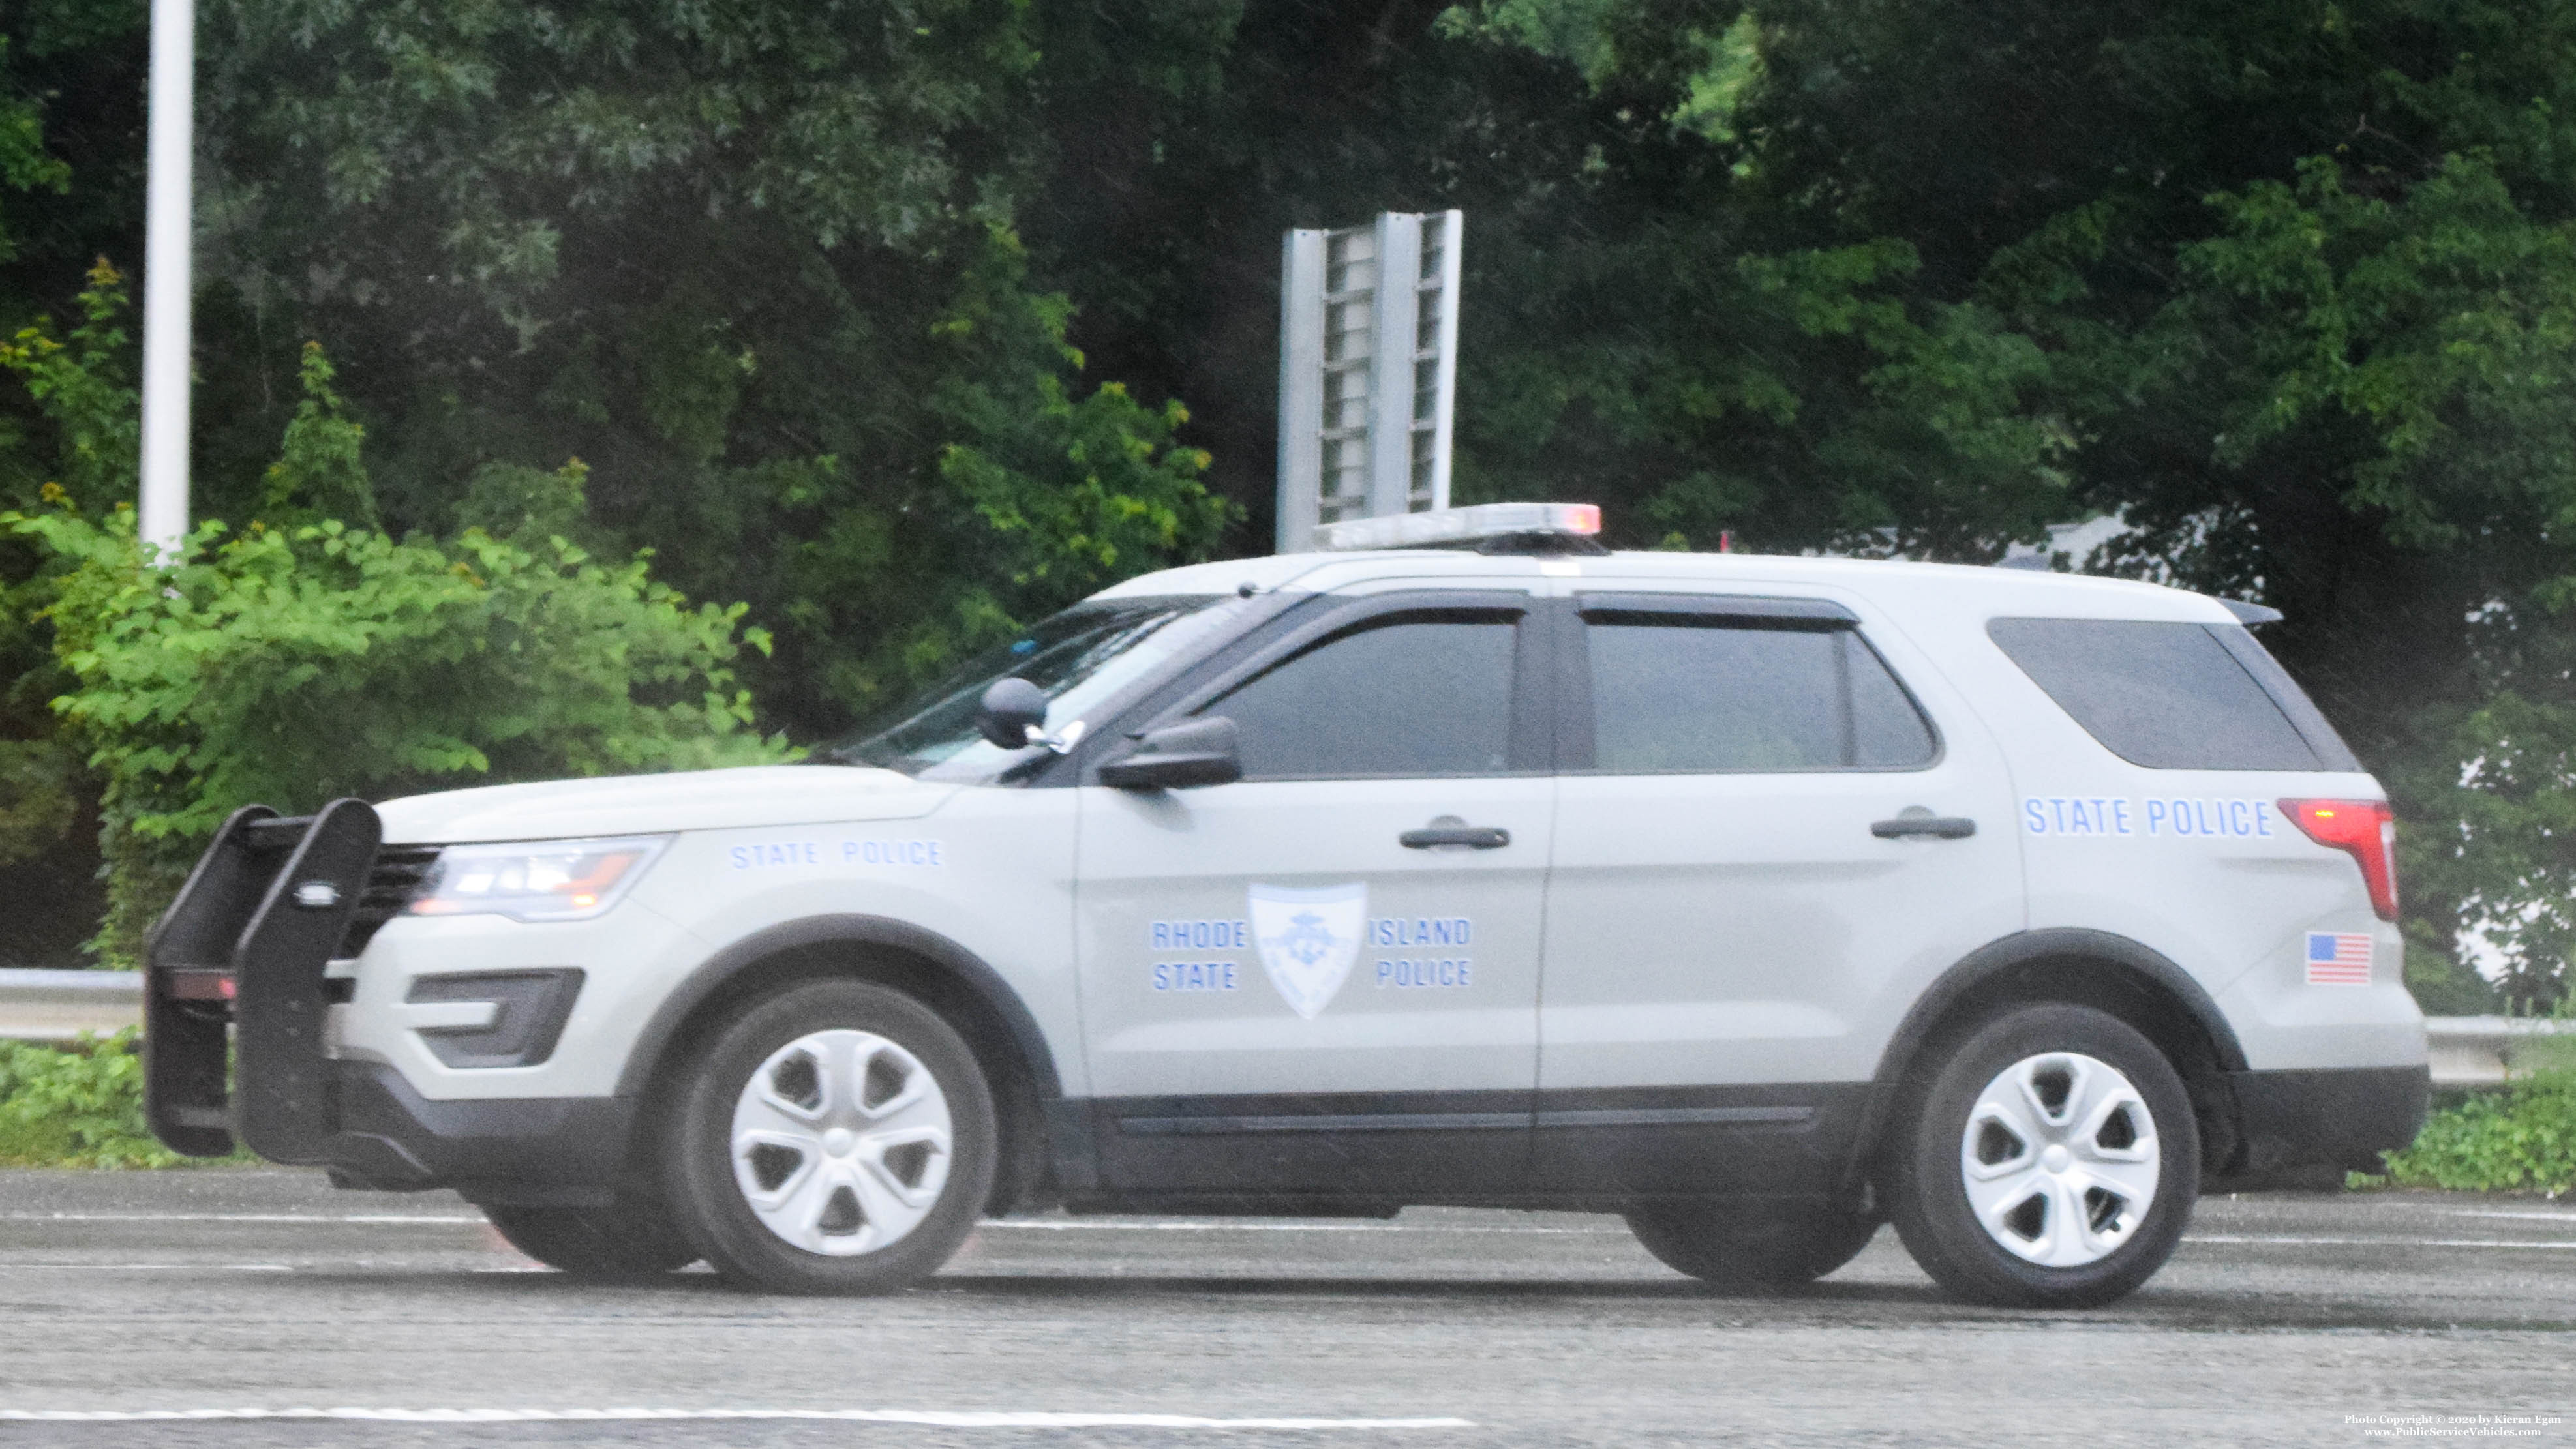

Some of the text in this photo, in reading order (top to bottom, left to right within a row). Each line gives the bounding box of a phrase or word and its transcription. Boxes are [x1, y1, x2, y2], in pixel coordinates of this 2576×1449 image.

[2025, 798, 2272, 836] STATE POLICE
[729, 841, 941, 870] STATE POLICE
[1152, 919, 1471, 949] RHODE ISLAND
[1153, 963, 1237, 991] STATE
[1376, 959, 1471, 987] POLICE
